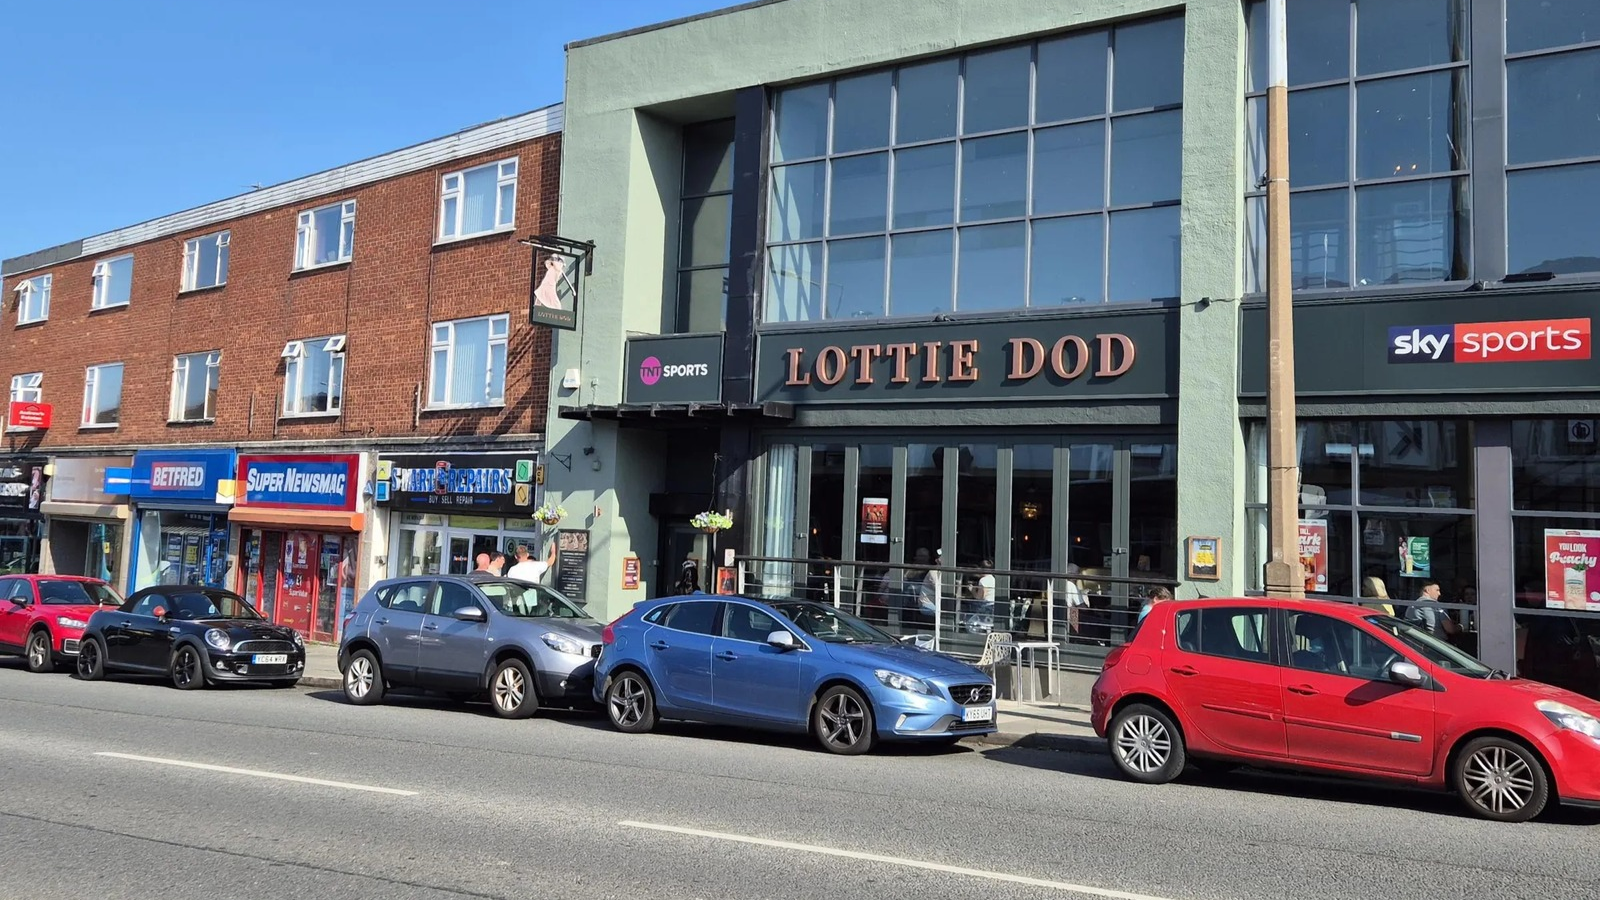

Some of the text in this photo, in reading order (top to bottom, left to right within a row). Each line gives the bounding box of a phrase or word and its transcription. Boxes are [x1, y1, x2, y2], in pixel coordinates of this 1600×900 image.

[1394, 326, 1582, 359] sky sports
[785, 333, 1136, 386] LOTTIE DOD
[640, 363, 708, 378] TNT SPORTS
[152, 466, 204, 487] BETFRED
[247, 467, 346, 496] SUPER NEWSMAG
[391, 467, 513, 494] SMART REPAIRS
[428, 494, 474, 505] BUY SELL REPAIR
[1559, 542, 1587, 553] YOU LOOK
[1549, 551, 1598, 568] Peachy
[966, 709, 980, 719] KY65
